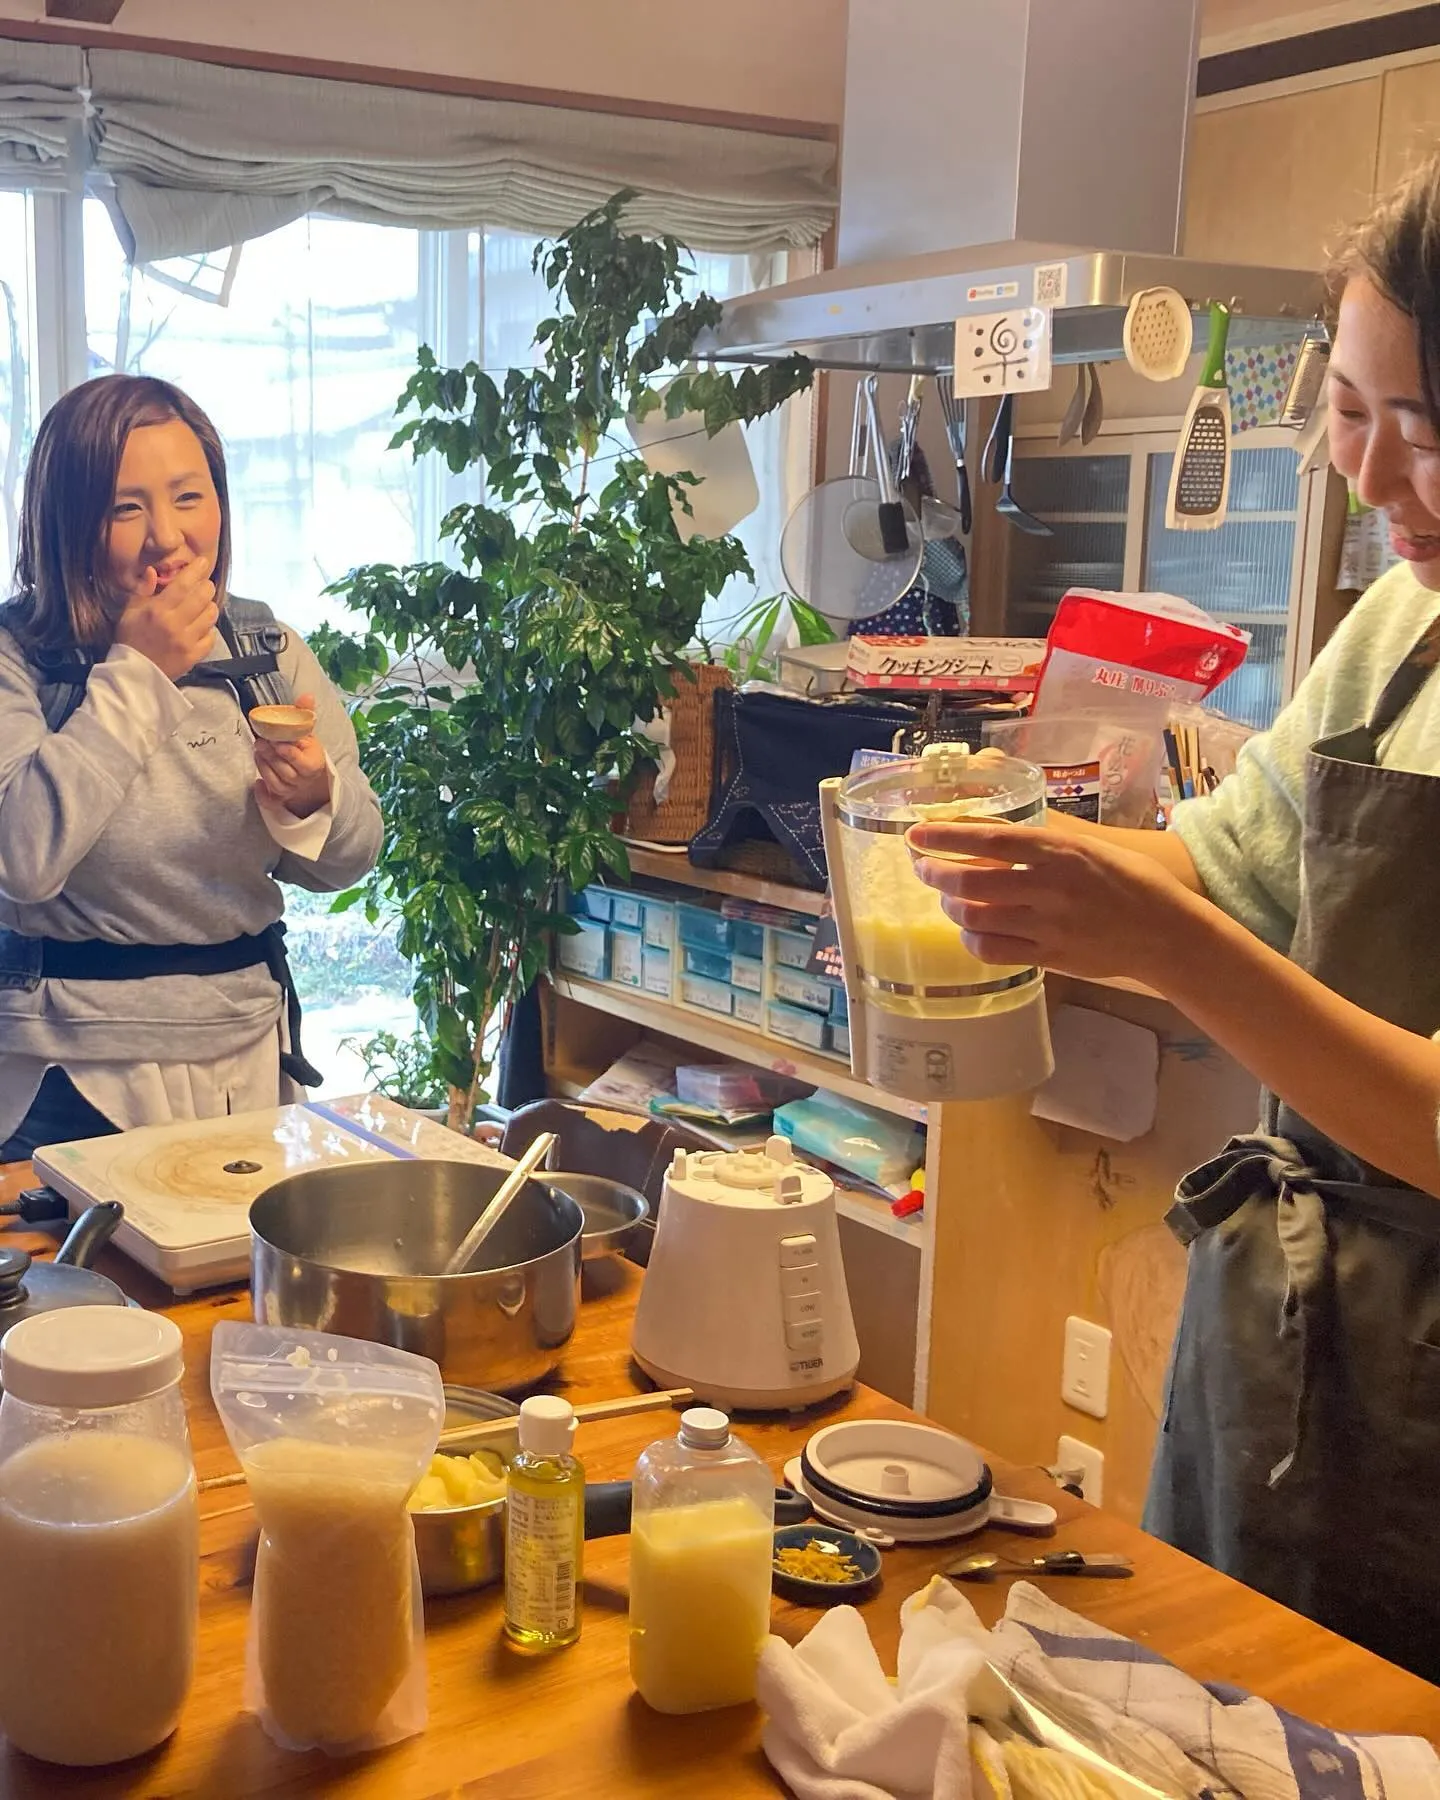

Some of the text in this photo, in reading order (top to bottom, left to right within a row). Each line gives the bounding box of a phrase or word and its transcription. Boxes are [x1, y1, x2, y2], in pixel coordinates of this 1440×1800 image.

[879, 656, 993, 675] クッキングシート
